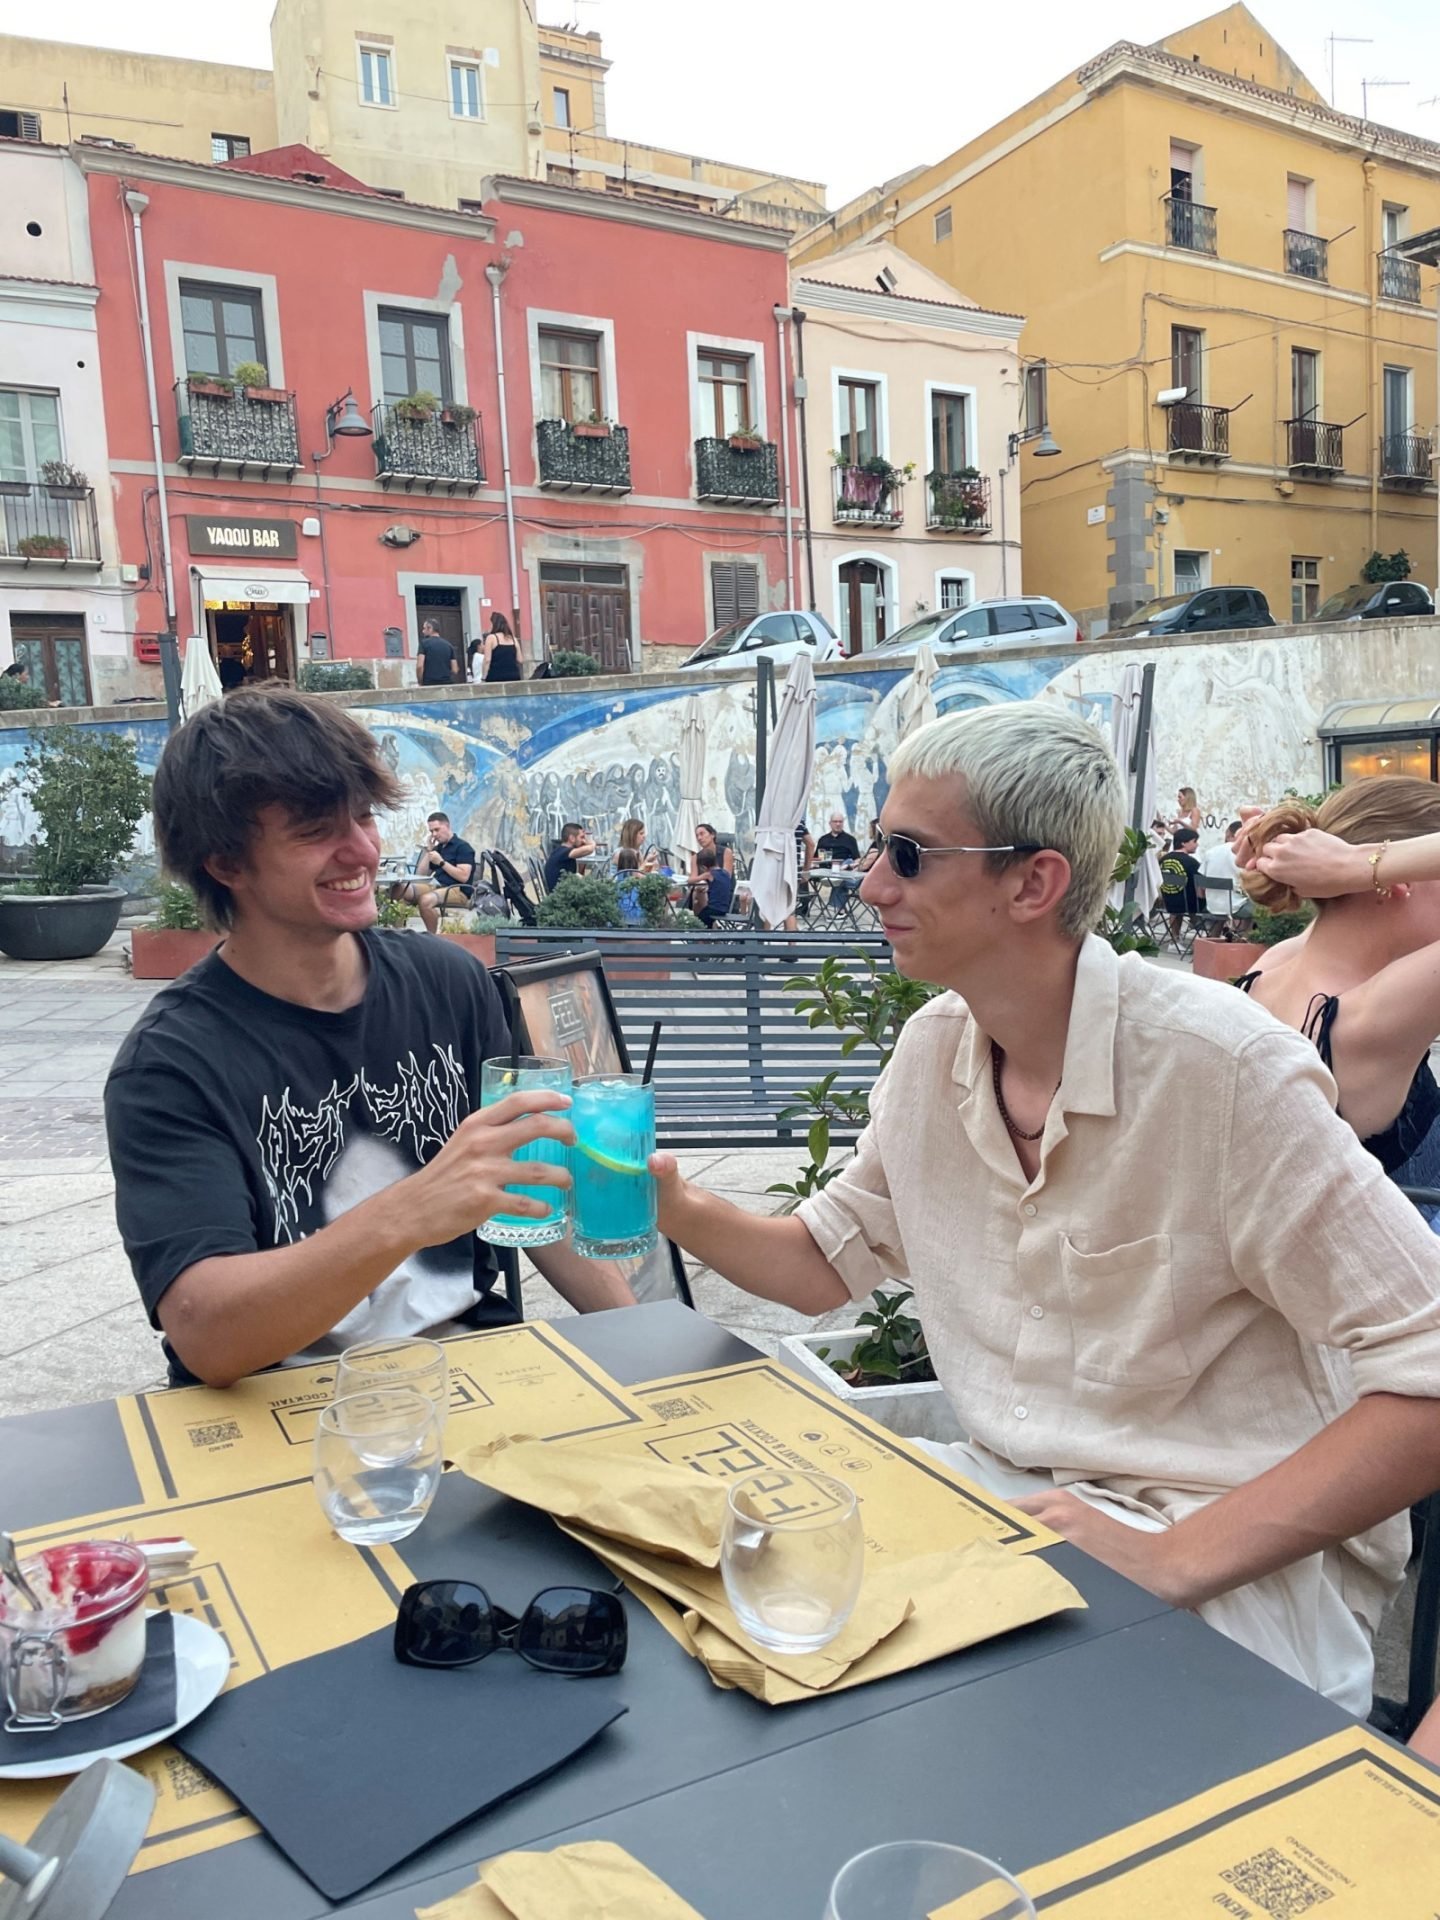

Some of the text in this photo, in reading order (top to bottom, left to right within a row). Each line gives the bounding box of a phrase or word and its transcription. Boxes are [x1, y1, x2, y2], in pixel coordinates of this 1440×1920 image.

[207, 526, 279, 547] YAQQU BAR
[268, 1392, 328, 1407] COCKTAIL
[740, 1418, 778, 1445] COCKTAIL
[1315, 1856, 1352, 1885] NOSTRI
